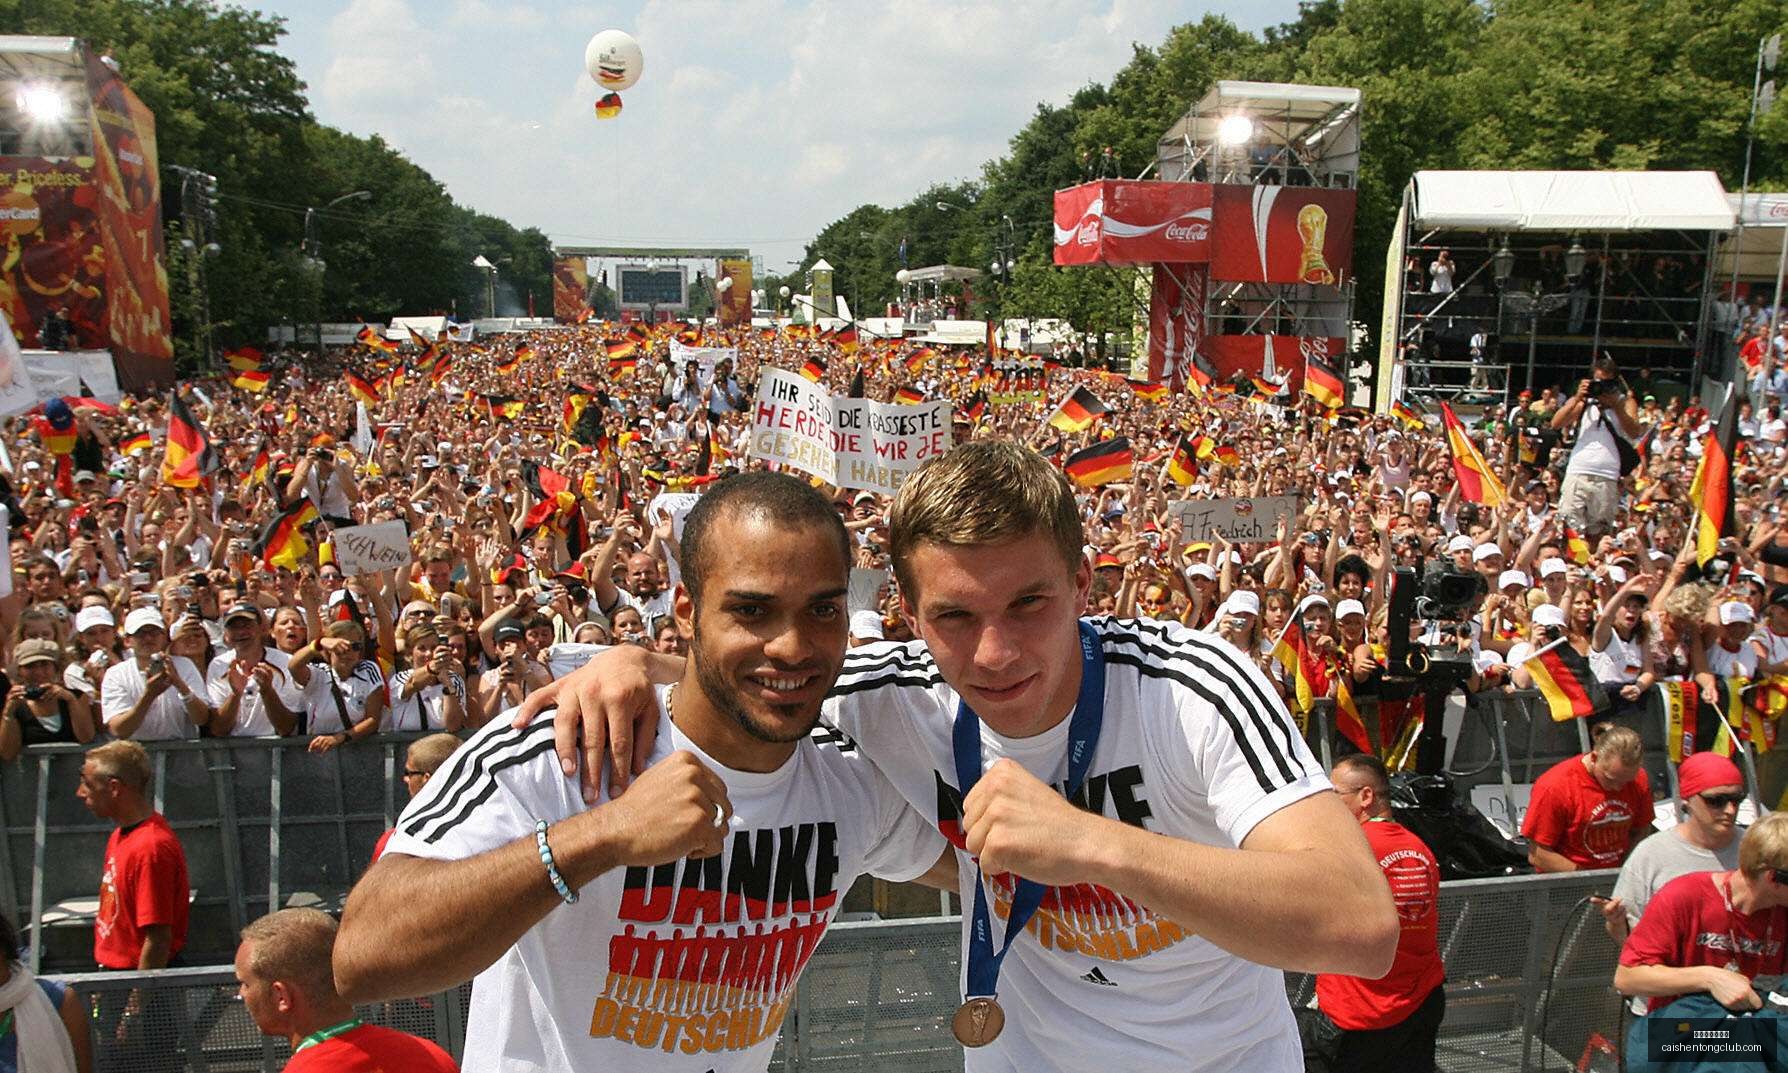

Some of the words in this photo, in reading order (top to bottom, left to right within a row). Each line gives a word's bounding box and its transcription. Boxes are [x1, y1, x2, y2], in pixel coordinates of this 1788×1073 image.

[771, 378, 799, 403] IHR
[839, 408, 862, 429] DIE
[757, 431, 840, 479] GESEHEN
[851, 460, 909, 489] HABE
[829, 432, 862, 453] DIE
[873, 438, 909, 460] WIR
[917, 432, 945, 460] JE
[1199, 508, 1263, 541] Friedrich
[1081, 635, 1095, 661] FIFA
[1072, 740, 1087, 764] FIFA
[617, 821, 839, 924] DANKE
[1379, 850, 1430, 868] DEUTSCHLAND
[977, 918, 986, 943] FIFA
